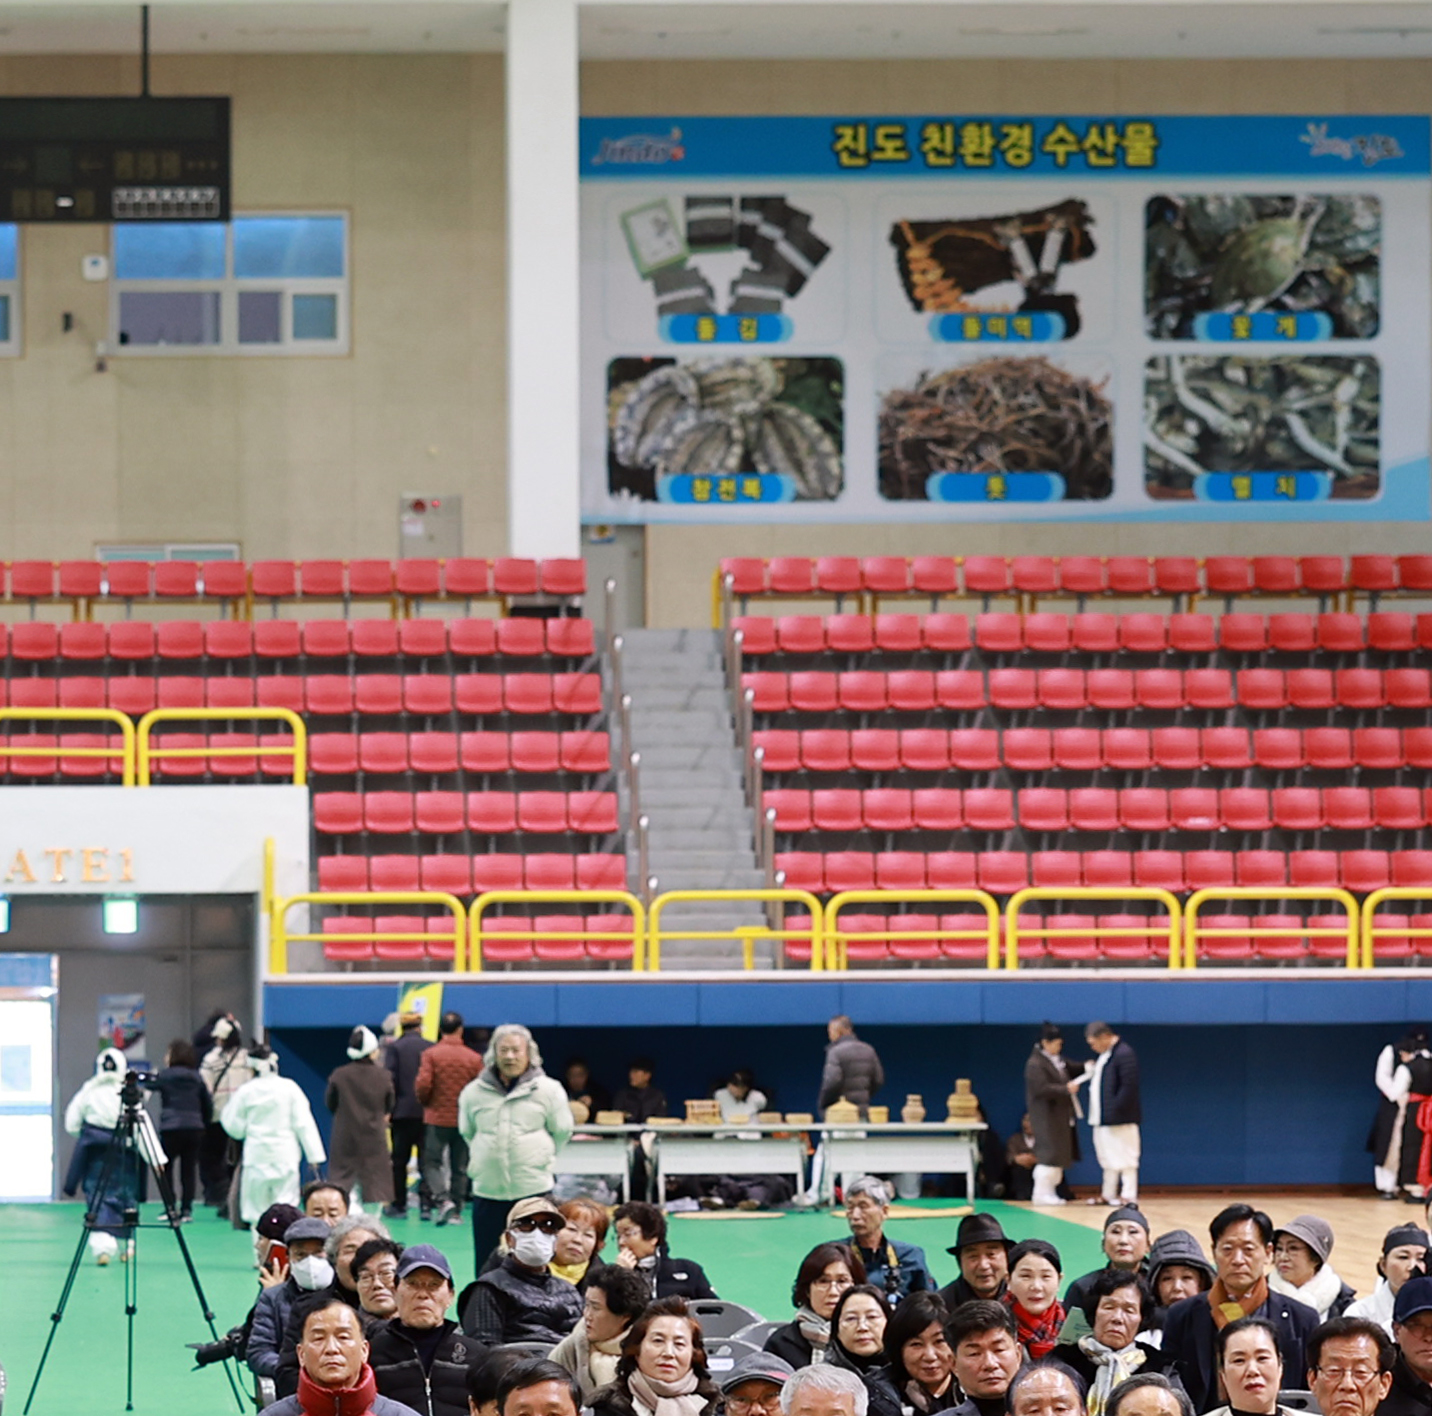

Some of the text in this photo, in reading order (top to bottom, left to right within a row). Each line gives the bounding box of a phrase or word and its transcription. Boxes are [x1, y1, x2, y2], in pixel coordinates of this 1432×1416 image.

[833, 122, 1158, 168] 진도 친환경 수산물
